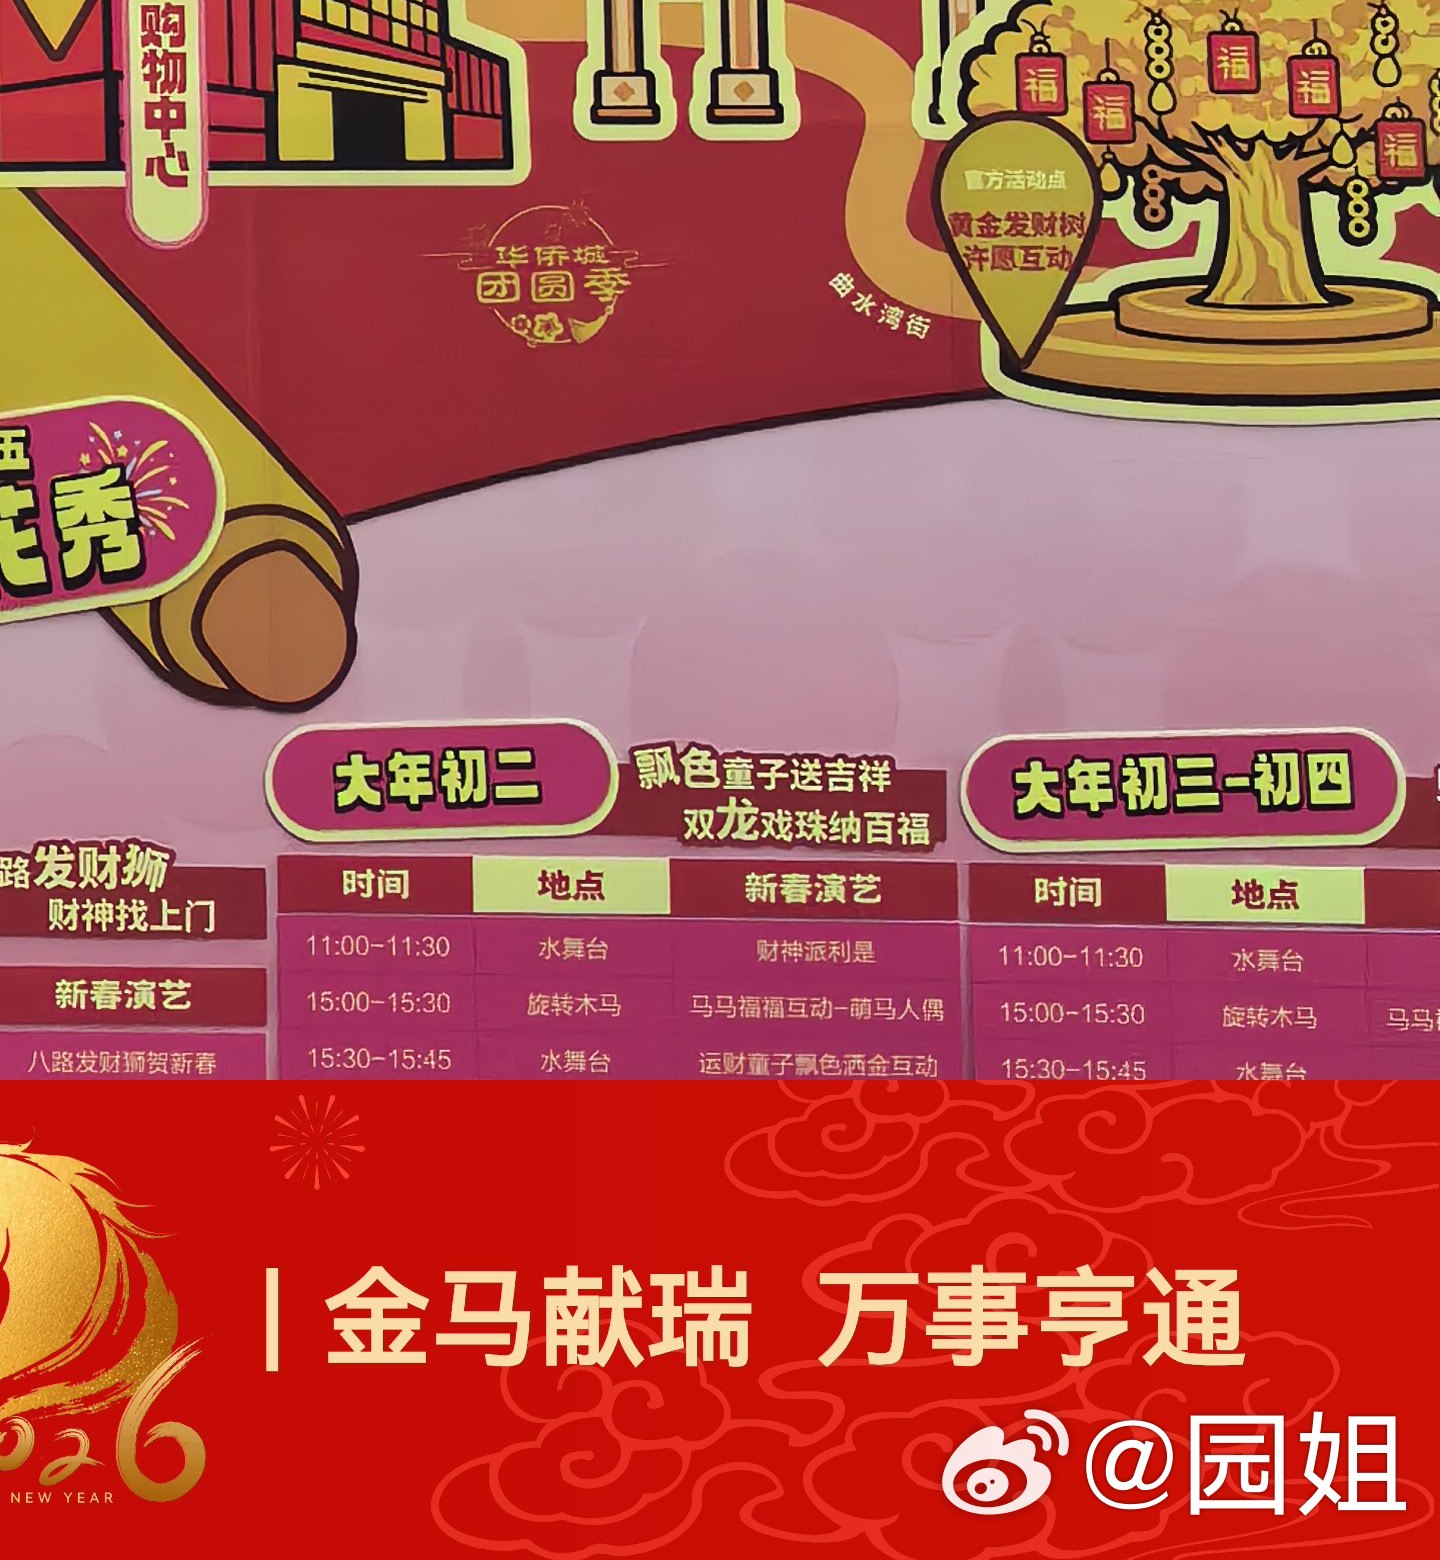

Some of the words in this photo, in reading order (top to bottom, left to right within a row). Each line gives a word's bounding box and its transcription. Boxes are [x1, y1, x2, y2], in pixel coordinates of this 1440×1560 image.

[1216, 45, 1250, 80] 福
[139, 1, 191, 189] 购物中心
[1023, 68, 1058, 104] 福
[1297, 70, 1331, 107] 福
[1090, 95, 1127, 132] 福
[1384, 132, 1419, 168] 福
[494, 244, 610, 269] 华侨城
[476, 267, 632, 304] 团圆季
[333, 748, 542, 811] 大年初二
[634, 745, 892, 792] 飘色童子送吉祥
[1015, 751, 1353, 814] 大年初三-初四
[683, 796, 931, 845] 双龙戏珠纳百福
[341, 868, 410, 901] 时间
[537, 869, 606, 903] 地点
[744, 872, 883, 905] 新春演艺
[1034, 876, 1102, 908] 时间
[1231, 879, 1300, 910] 地点
[47, 898, 217, 933] 财神找上门
[306, 935, 450, 958] 11:00-11:30
[537, 937, 609, 962] 水舞台
[998, 945, 1144, 968] 11:00-11:30
[1232, 948, 1304, 973] 水舞台
[54, 977, 193, 1012] 新春演艺
[306, 991, 451, 1015] 15:00-15:30
[527, 991, 621, 1017] 旋转木马
[1000, 1002, 1145, 1025] 15:00-15:30
[1222, 1004, 1318, 1030] 旋转木马
[307, 1048, 452, 1072] 15:30-15:45
[1001, 1058, 1147, 1080] 15:30-15:45
